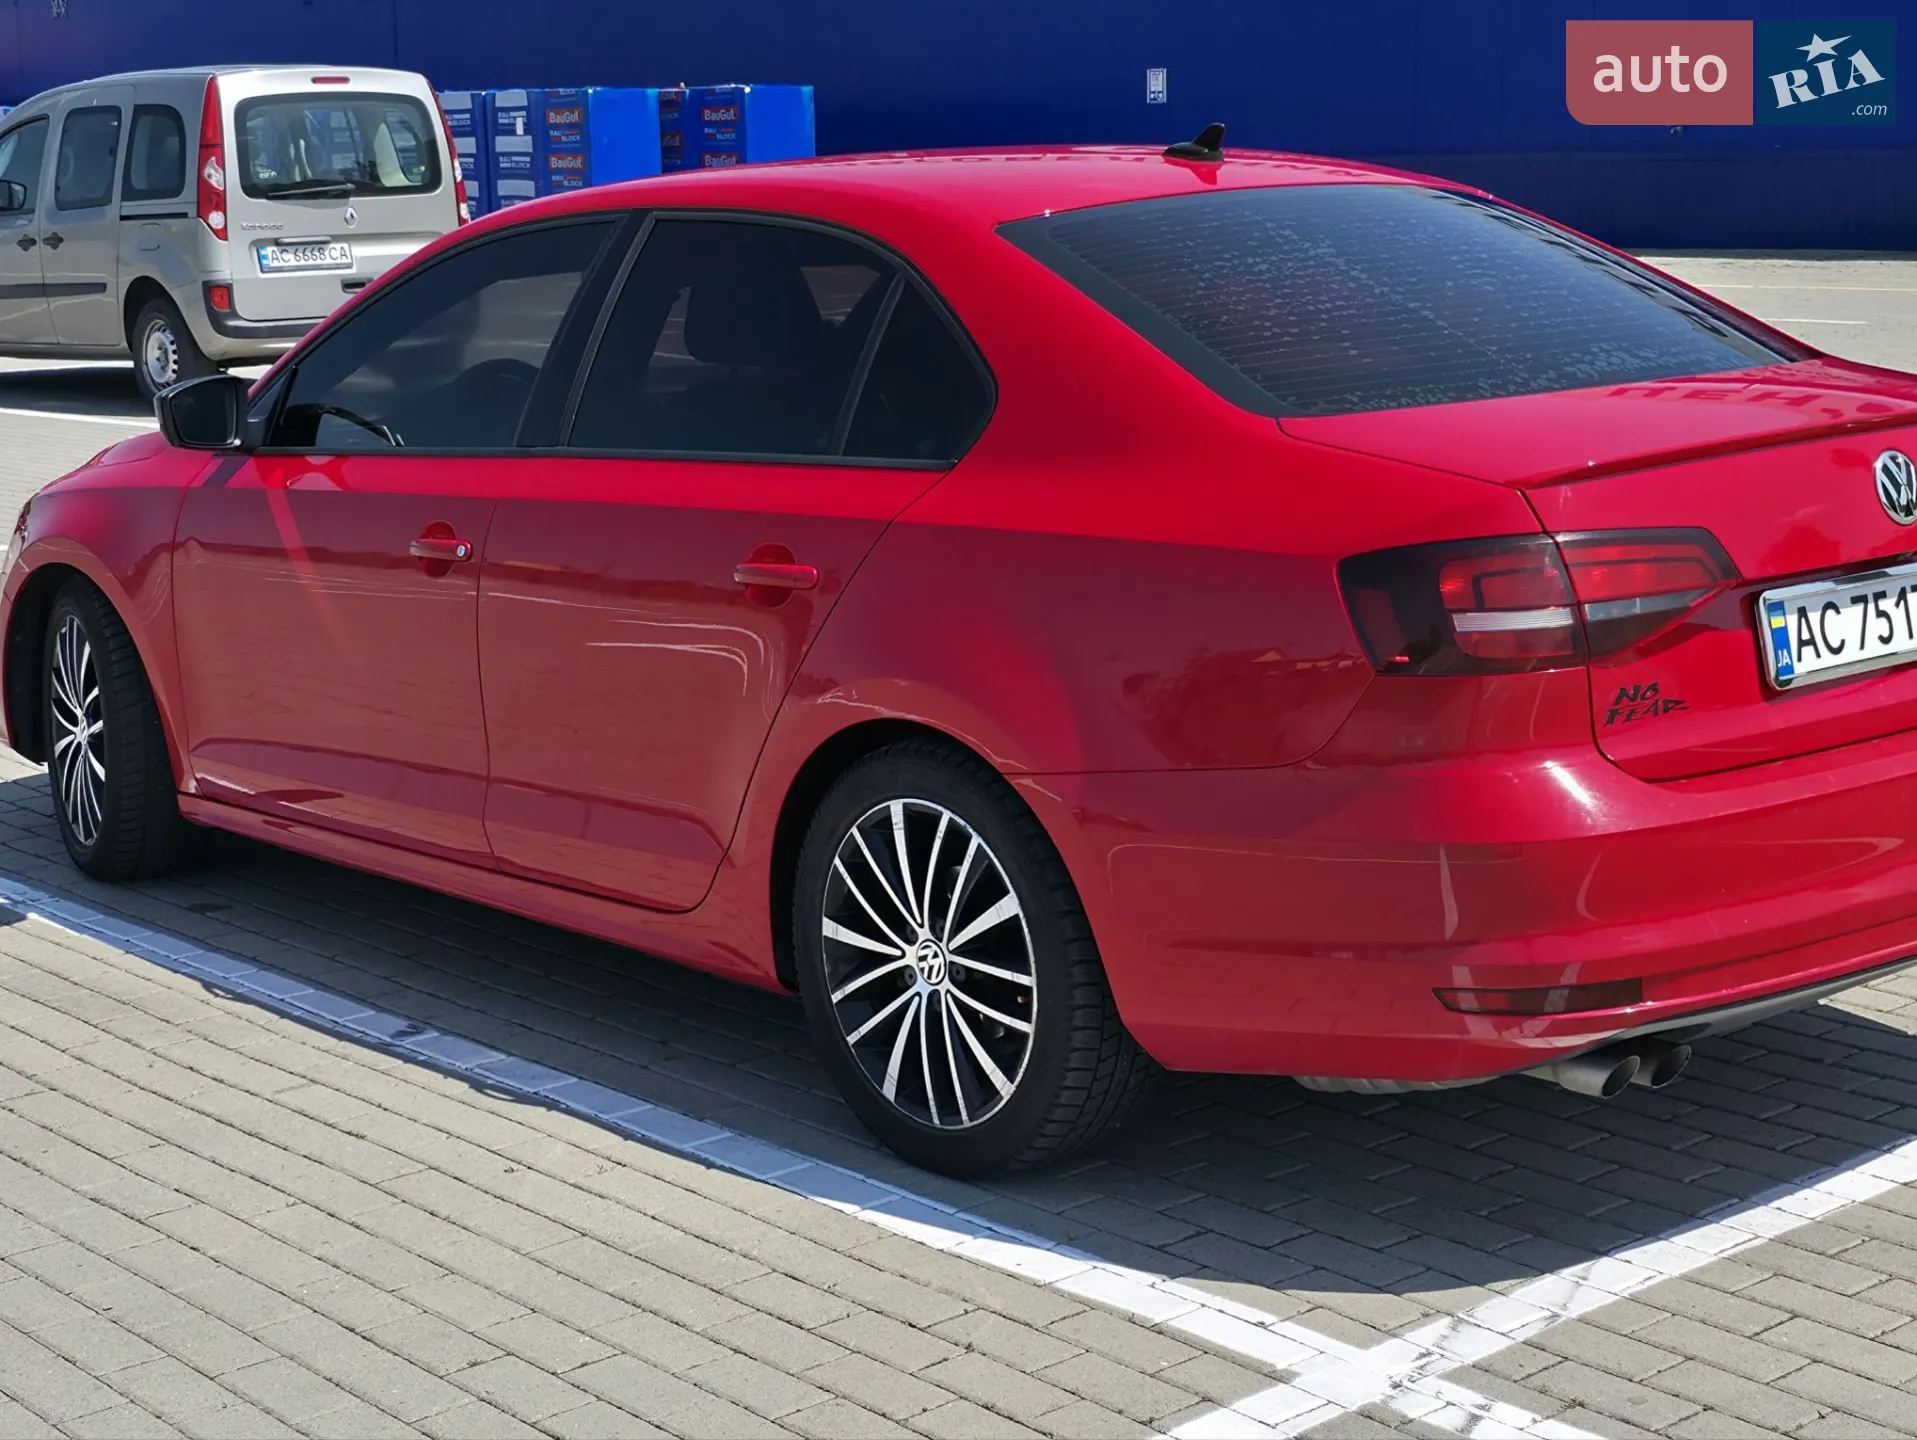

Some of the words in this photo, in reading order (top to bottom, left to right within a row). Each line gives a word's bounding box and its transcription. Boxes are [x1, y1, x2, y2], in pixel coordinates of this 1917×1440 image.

[549, 110, 580, 124] BauGut
[704, 108, 735, 120] BauGut
[550, 156, 583, 169] BauGut
[271, 249, 291, 263] AC
[293, 247, 327, 262] 6668
[328, 246, 349, 261] CA
[1797, 601, 1846, 663] AC
[1613, 681, 1660, 706] NO
[1604, 697, 1690, 727] FEAR
